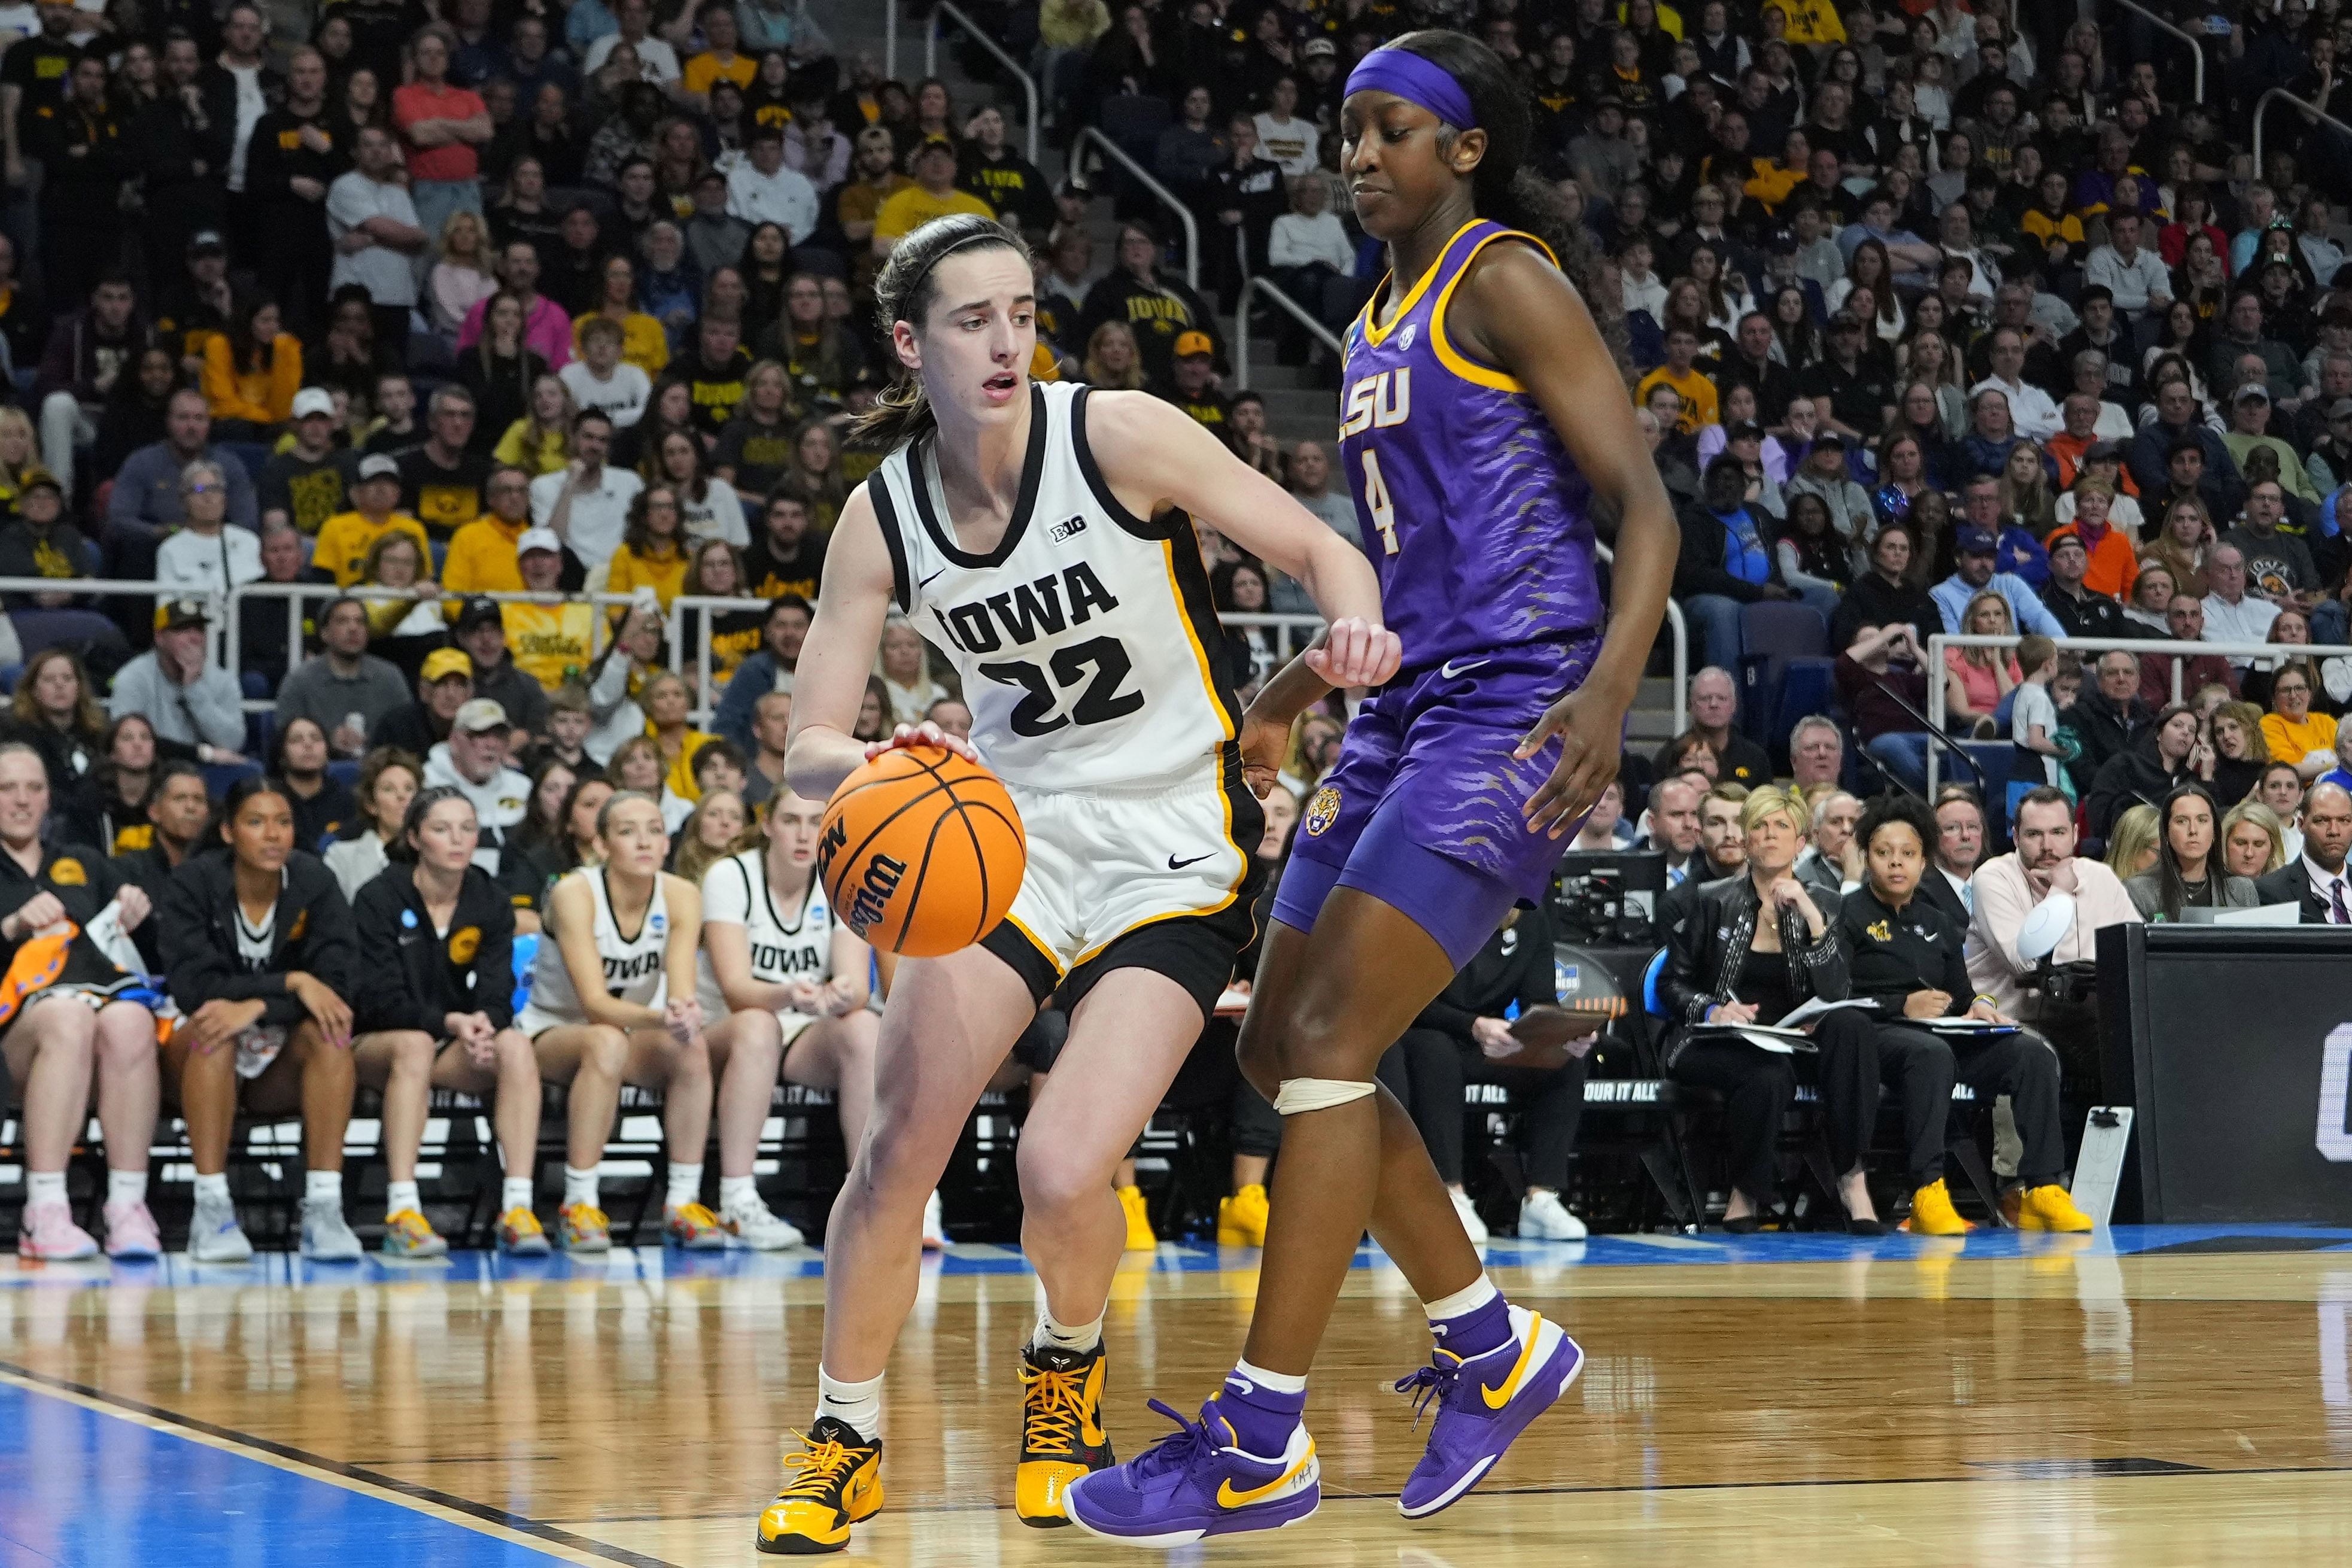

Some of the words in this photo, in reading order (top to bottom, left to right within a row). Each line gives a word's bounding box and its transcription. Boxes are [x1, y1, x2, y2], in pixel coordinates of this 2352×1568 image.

[1127, 297, 1187, 326] IOWA
[1362, 448, 1400, 555] 4
[929, 561, 1119, 654] IOWA
[977, 636, 1145, 737] 22
[752, 942, 821, 973] IOWA
[1466, 1084, 1480, 1103] IT
[1481, 1084, 1508, 1103] ALL
[1616, 1082, 1631, 1102] IT
[1951, 1082, 1975, 1100] ALL
